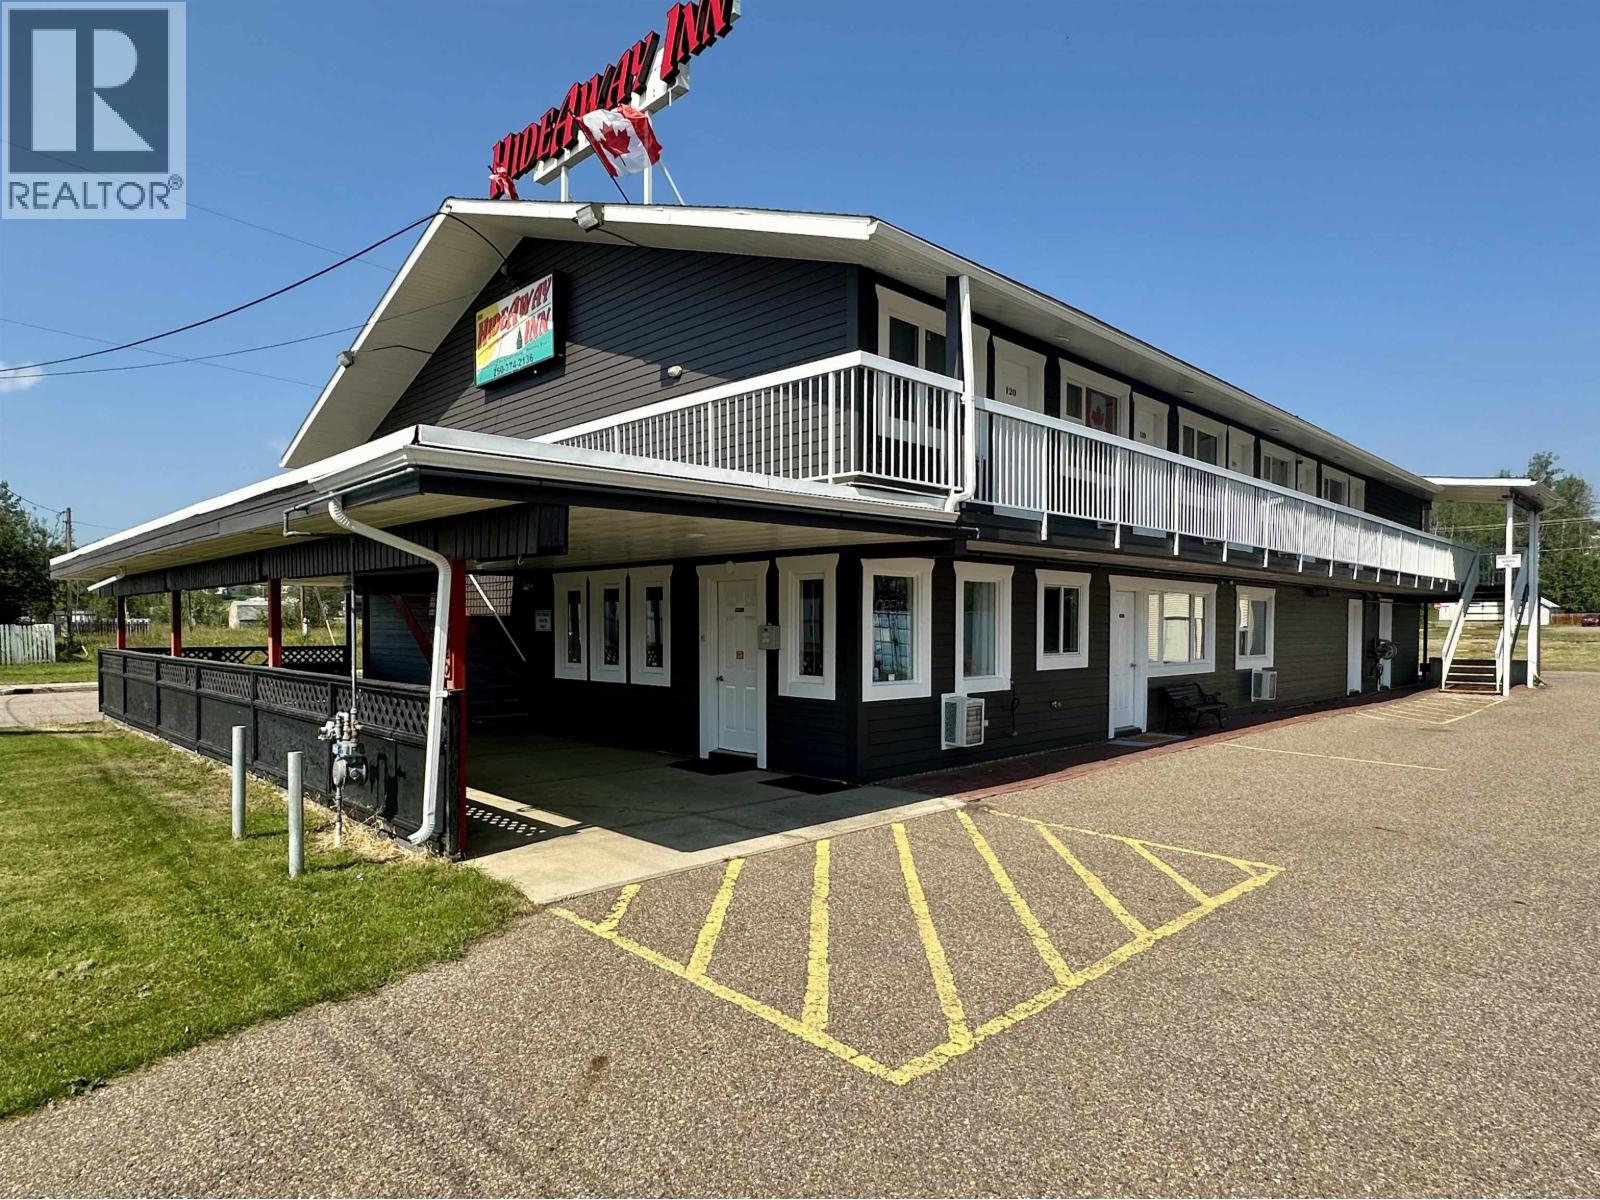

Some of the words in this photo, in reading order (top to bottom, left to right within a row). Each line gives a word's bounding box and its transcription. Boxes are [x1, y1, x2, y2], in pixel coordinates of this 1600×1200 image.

[660, 0, 733, 82] INN
[478, 276, 551, 350] HIDEAWAY
[524, 307, 551, 345] INN
[875, 599, 904, 612] OPEN
